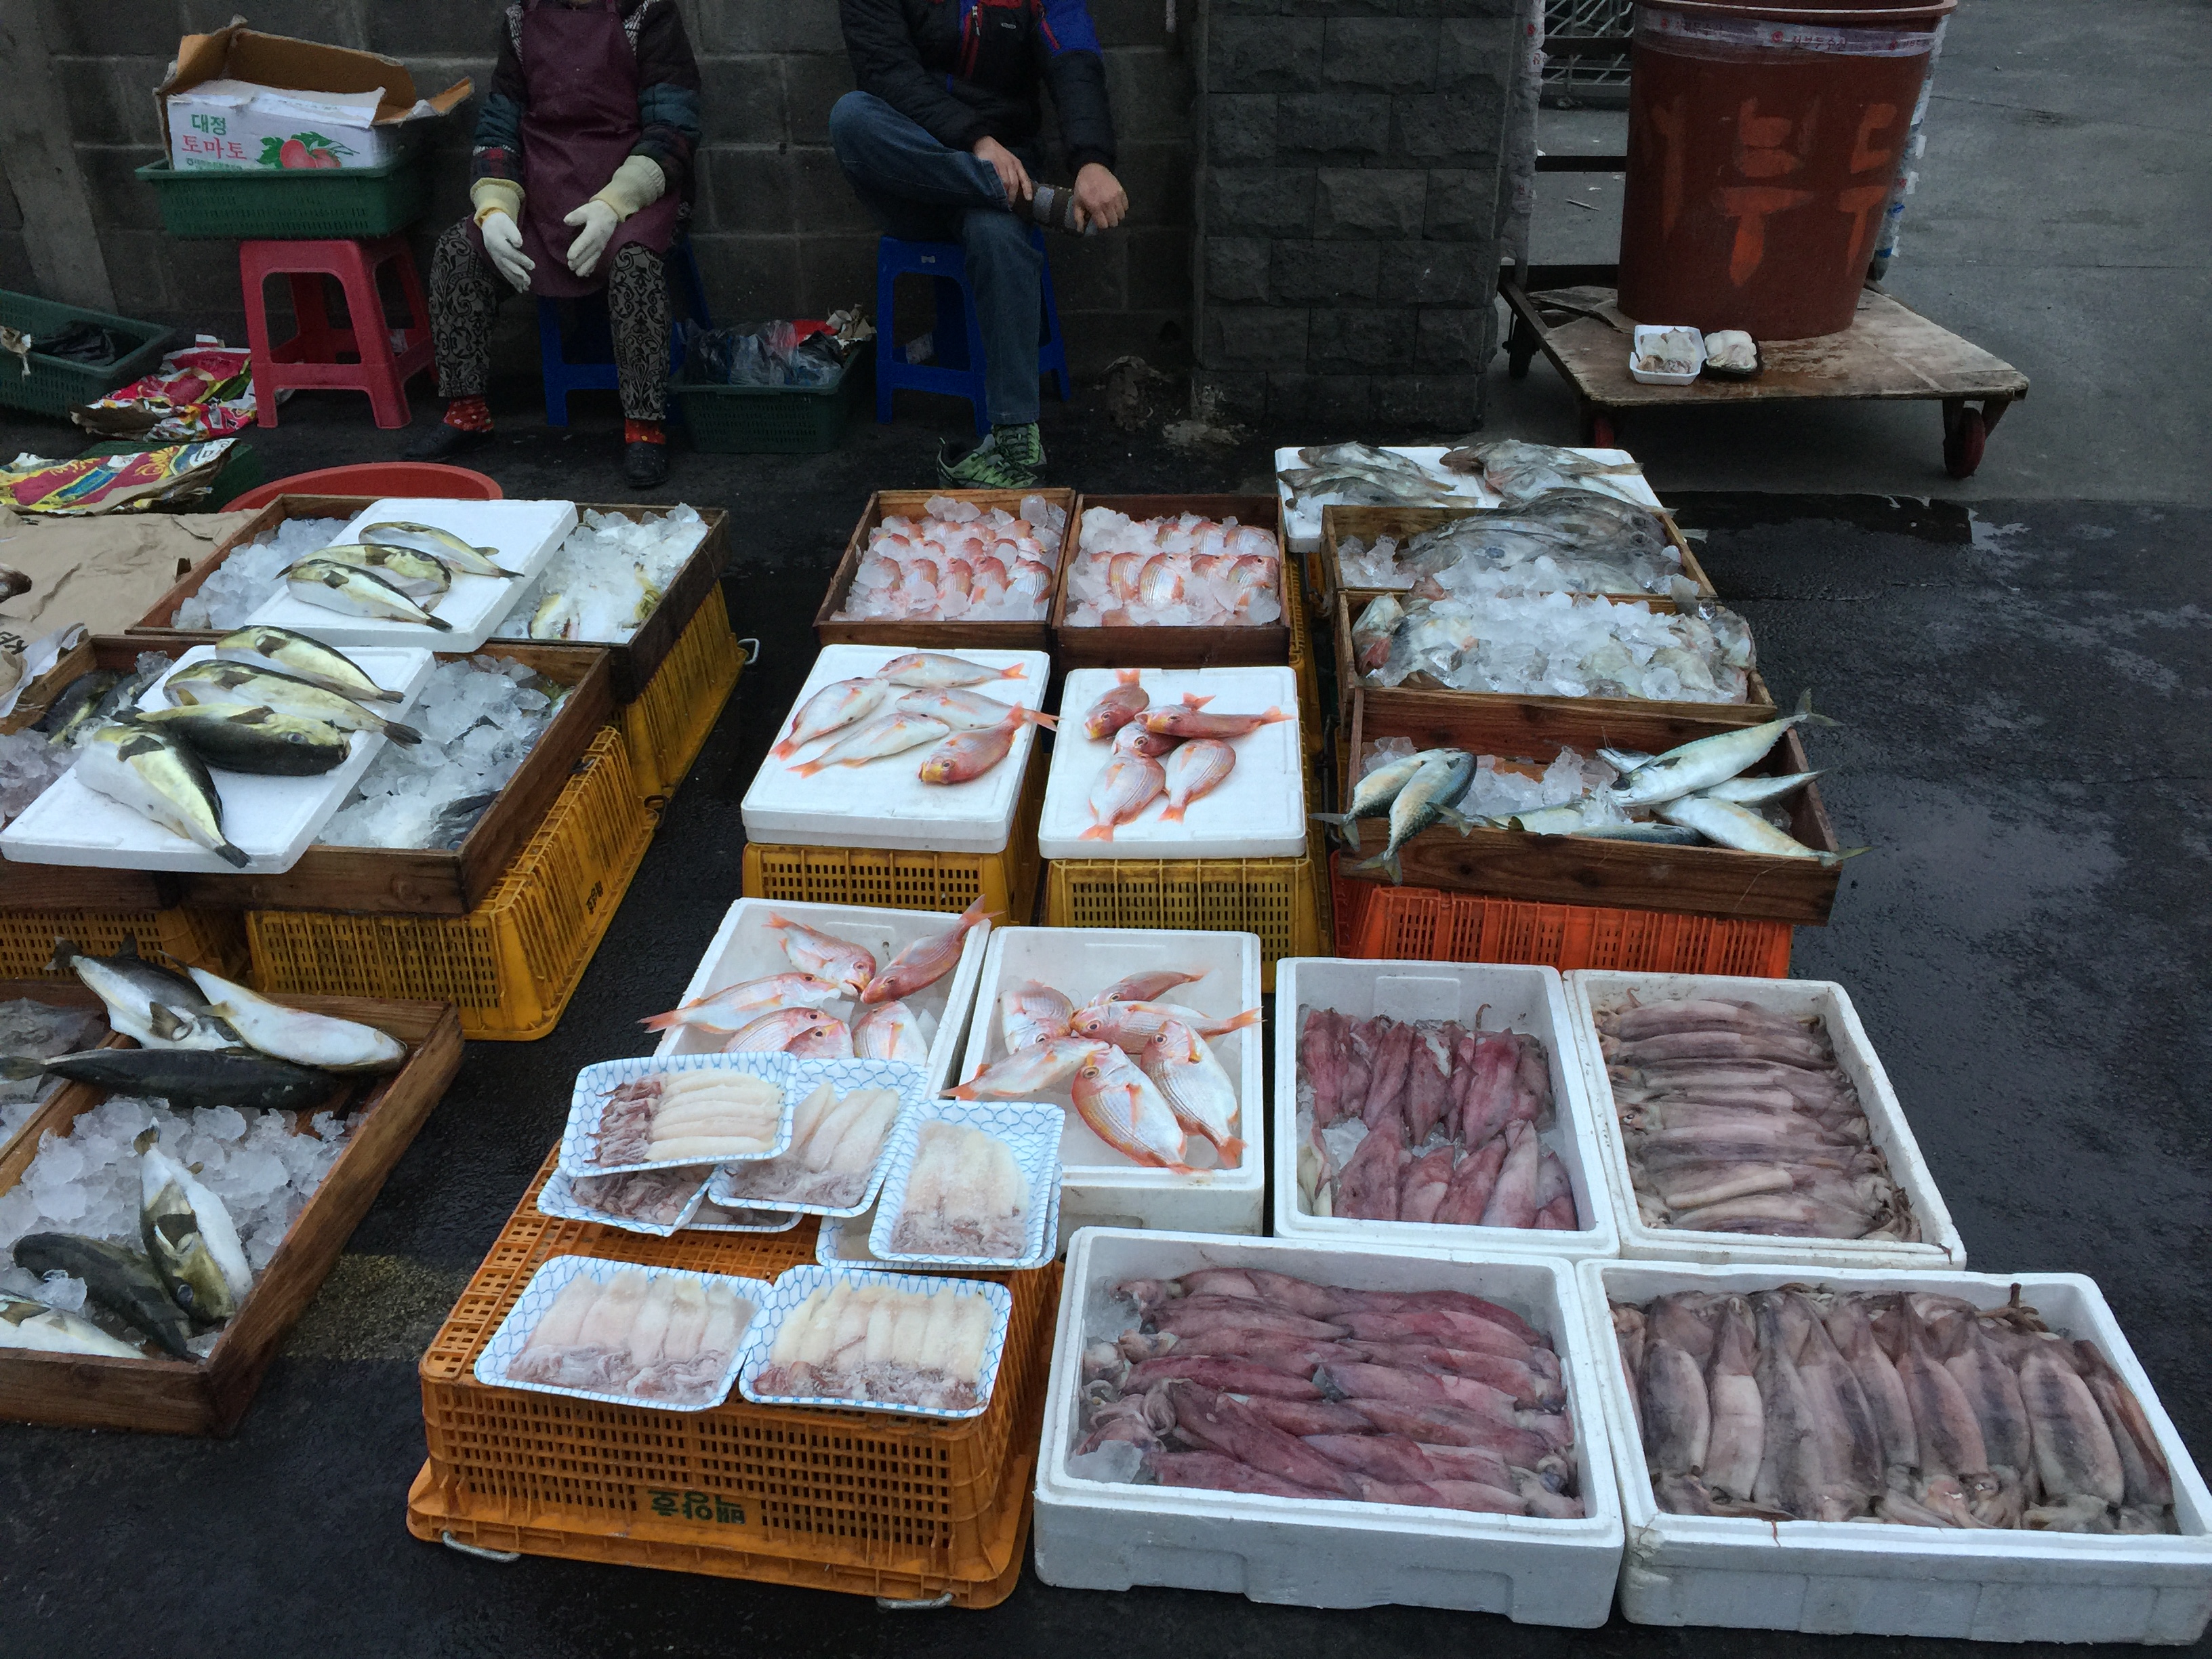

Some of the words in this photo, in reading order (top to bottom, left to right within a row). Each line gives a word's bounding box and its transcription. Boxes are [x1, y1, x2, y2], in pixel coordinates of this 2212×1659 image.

[191, 114, 227, 136] 대정
[182, 135, 247, 160] 토마토
[648, 1490, 745, 1525] 백양호
